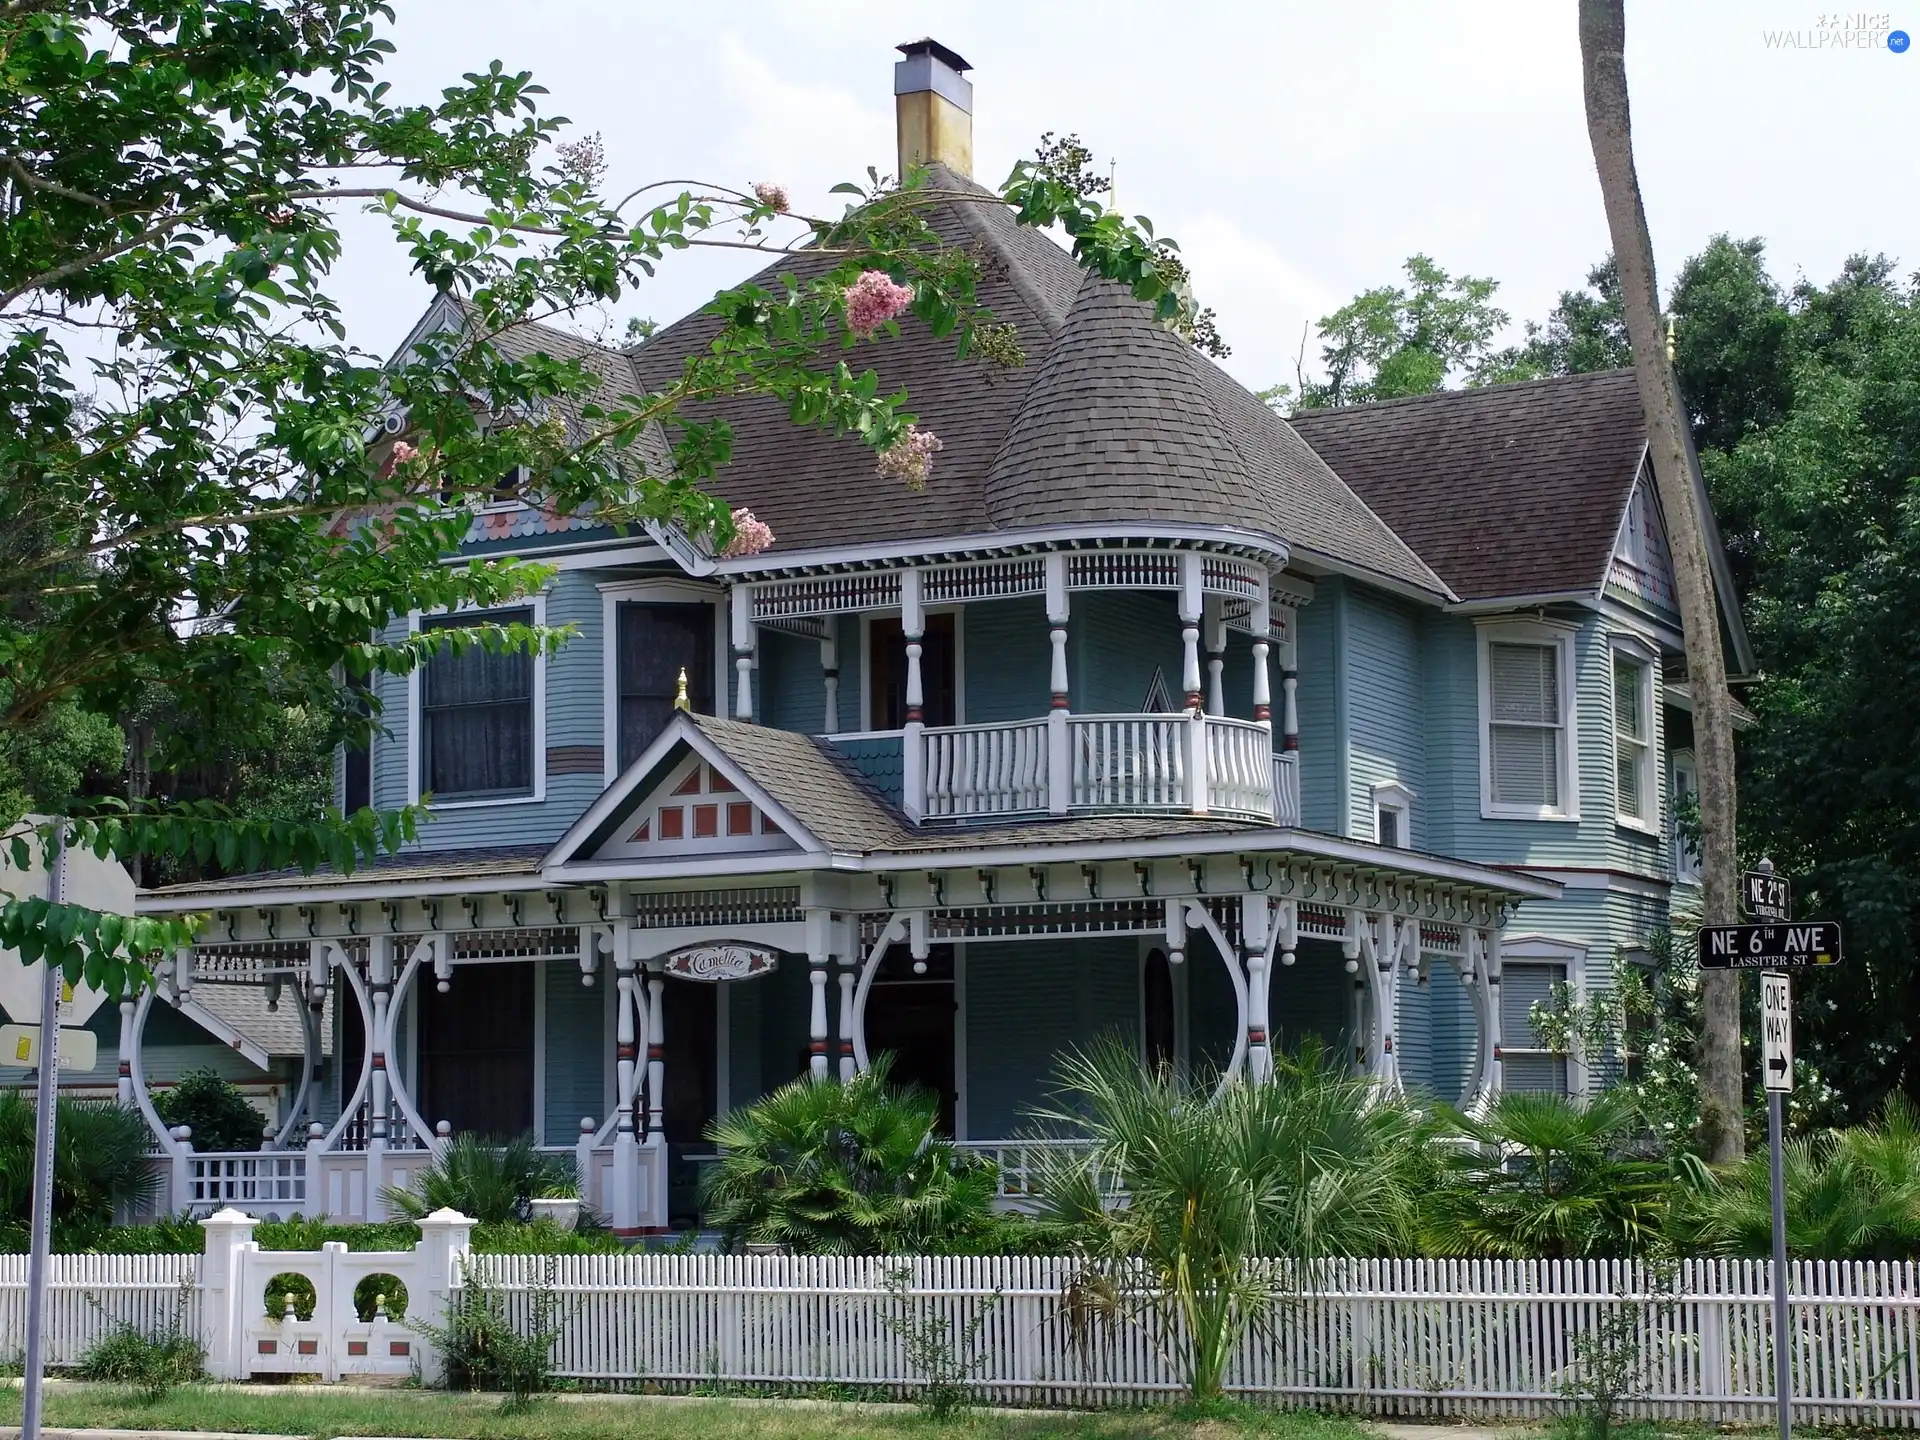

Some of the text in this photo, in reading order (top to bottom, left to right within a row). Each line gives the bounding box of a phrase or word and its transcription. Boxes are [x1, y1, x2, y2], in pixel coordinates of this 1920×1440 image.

[1751, 877, 1764, 903] NE
[1711, 927, 1825, 955] NE 6TH AVE
[1730, 955, 1788, 967] LASSITER
[1792, 954, 1808, 965] ST
[1766, 984, 1787, 1011] ONE
[1766, 1016, 1788, 1043] WAY
